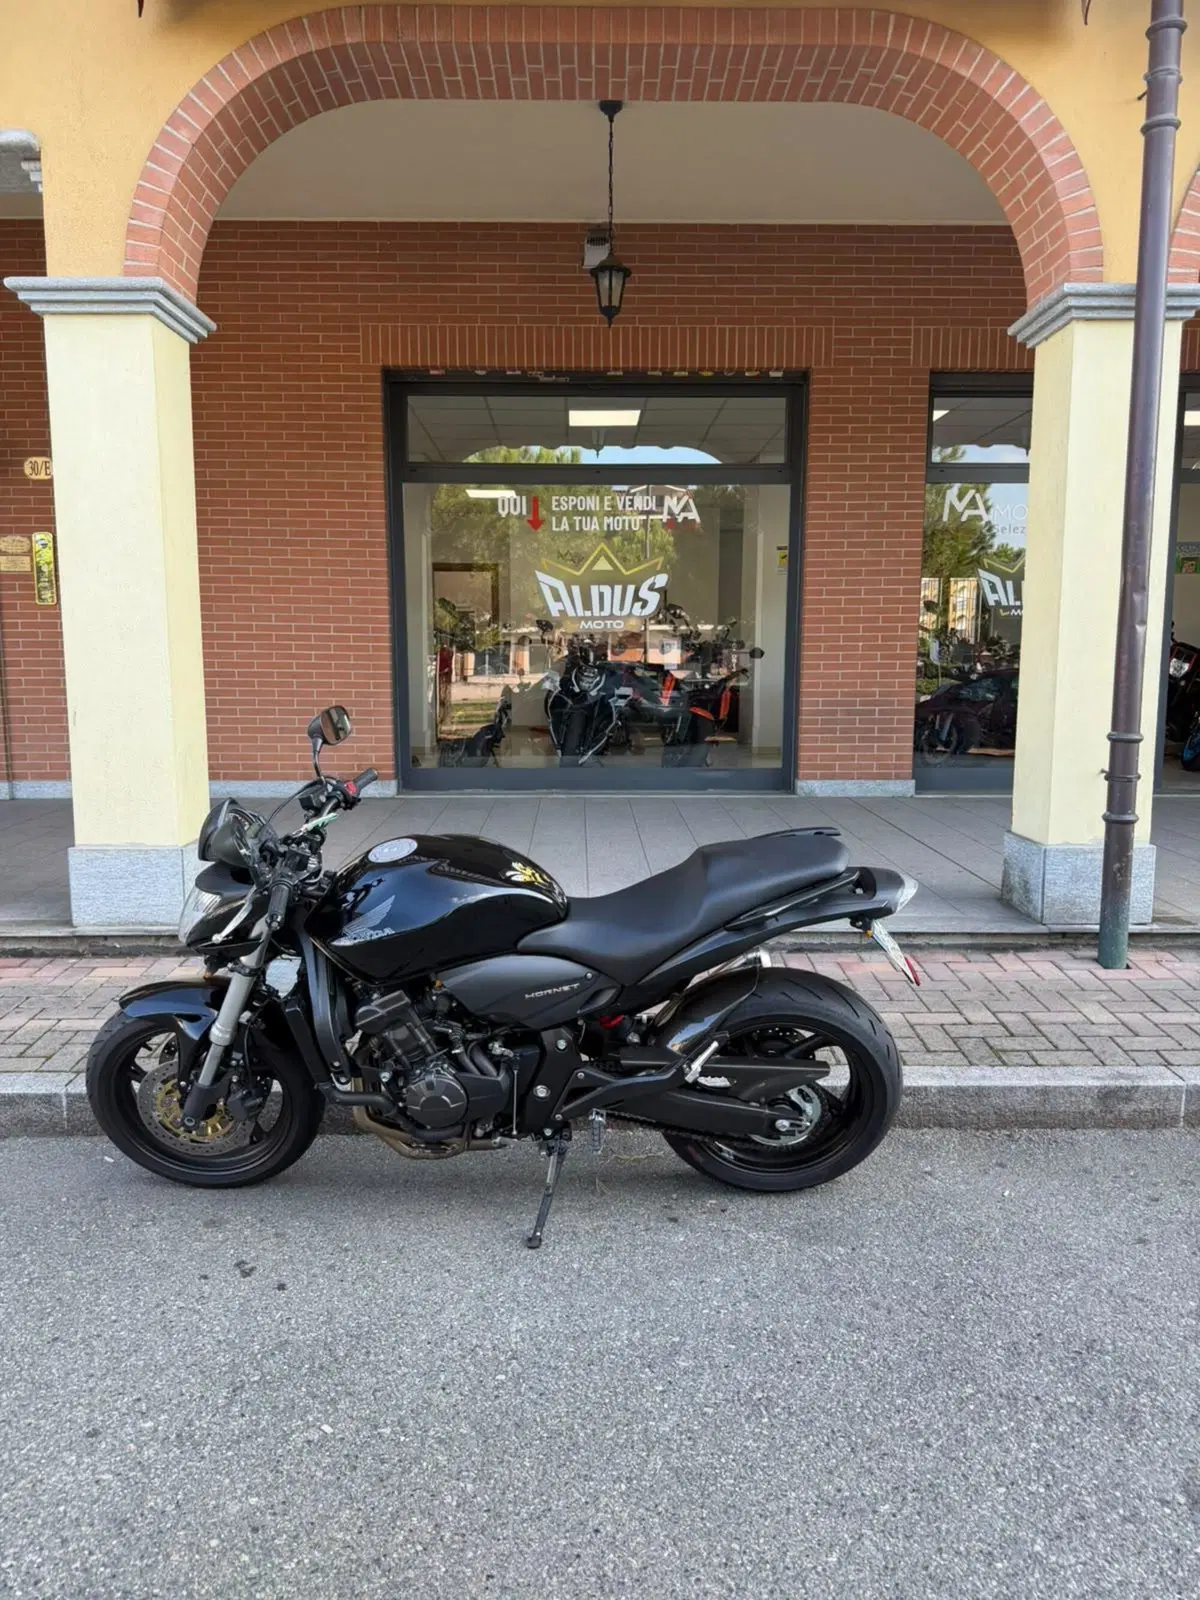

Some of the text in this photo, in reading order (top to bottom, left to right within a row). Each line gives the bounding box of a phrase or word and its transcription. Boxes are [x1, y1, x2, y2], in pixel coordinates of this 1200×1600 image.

[29, 460, 51, 476] 30/E
[498, 495, 527, 518] QUI
[552, 495, 656, 511] ESPONI E VENDI
[552, 516, 640, 531] LA TUA MOTO
[534, 569, 669, 617] ALDUS
[580, 620, 625, 629] MOTO
[524, 982, 580, 999] HORNET
